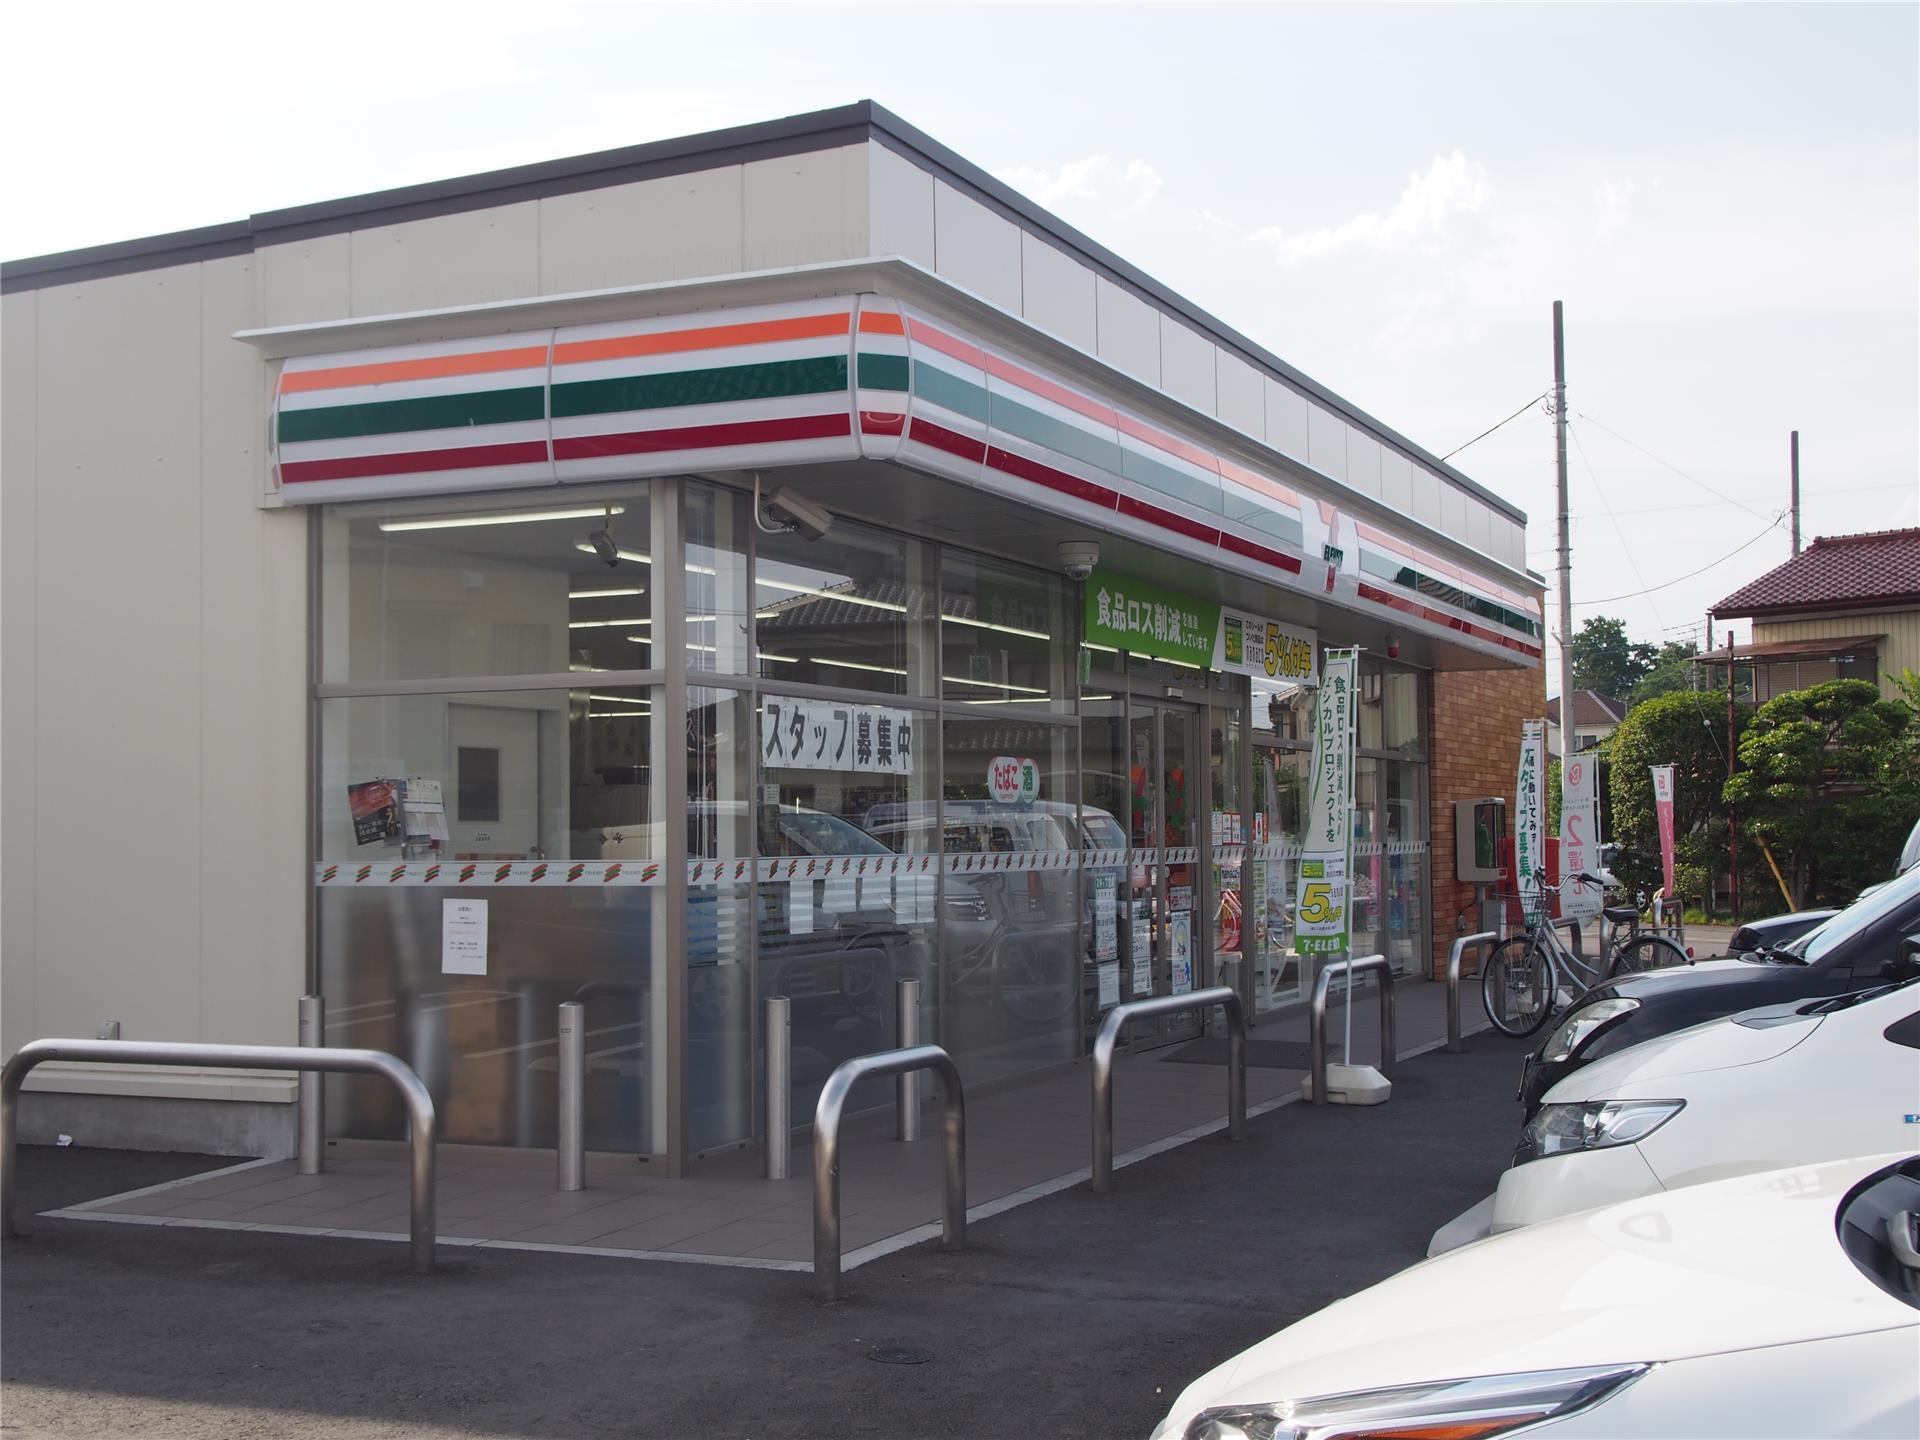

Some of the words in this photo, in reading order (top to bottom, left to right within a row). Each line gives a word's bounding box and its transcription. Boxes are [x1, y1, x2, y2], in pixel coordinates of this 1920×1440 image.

[1097, 586, 1181, 646] 食品ロス削減
[1264, 622, 1311, 679] 5%付与
[766, 704, 912, 770] スタッフ募集中
[994, 763, 1019, 791] たばこ
[1023, 765, 1033, 792] 酒
